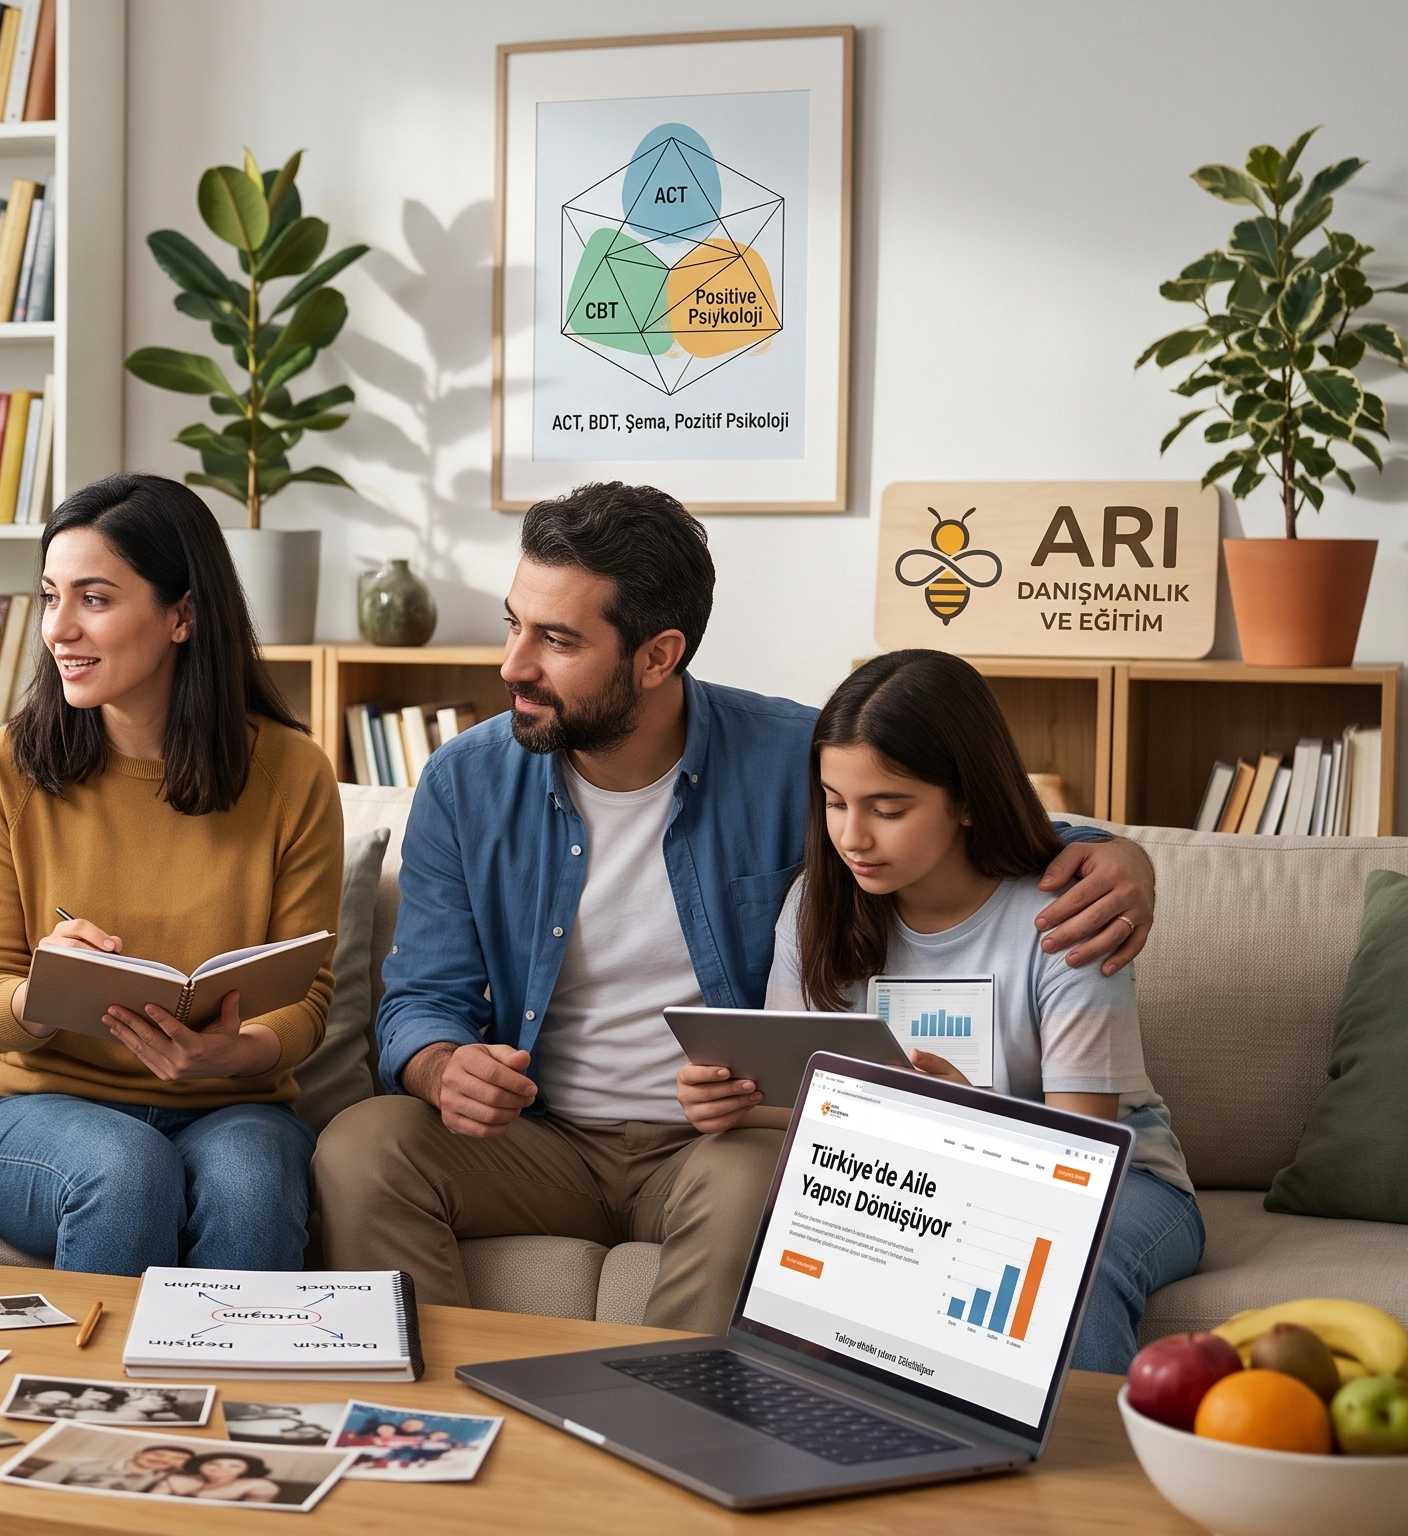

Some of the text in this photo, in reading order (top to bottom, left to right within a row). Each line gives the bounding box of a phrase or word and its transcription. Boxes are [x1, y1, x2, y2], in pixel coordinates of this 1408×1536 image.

[654, 186, 688, 204] ACT
[696, 287, 757, 305] Positive
[585, 302, 619, 319] CBT
[552, 411, 789, 433] ACT, BDT, Şema, Pozitif Psikoloji
[1030, 505, 1178, 568] ARI
[1017, 582, 1190, 605] DANIŞMANLIK
[1040, 608, 1163, 632] VE EĞİTİM
[811, 1143, 937, 1198] Türkiye'de Aile
[802, 1173, 852, 1206] Yapısı
[854, 1190, 952, 1238] Dönüşüyor
